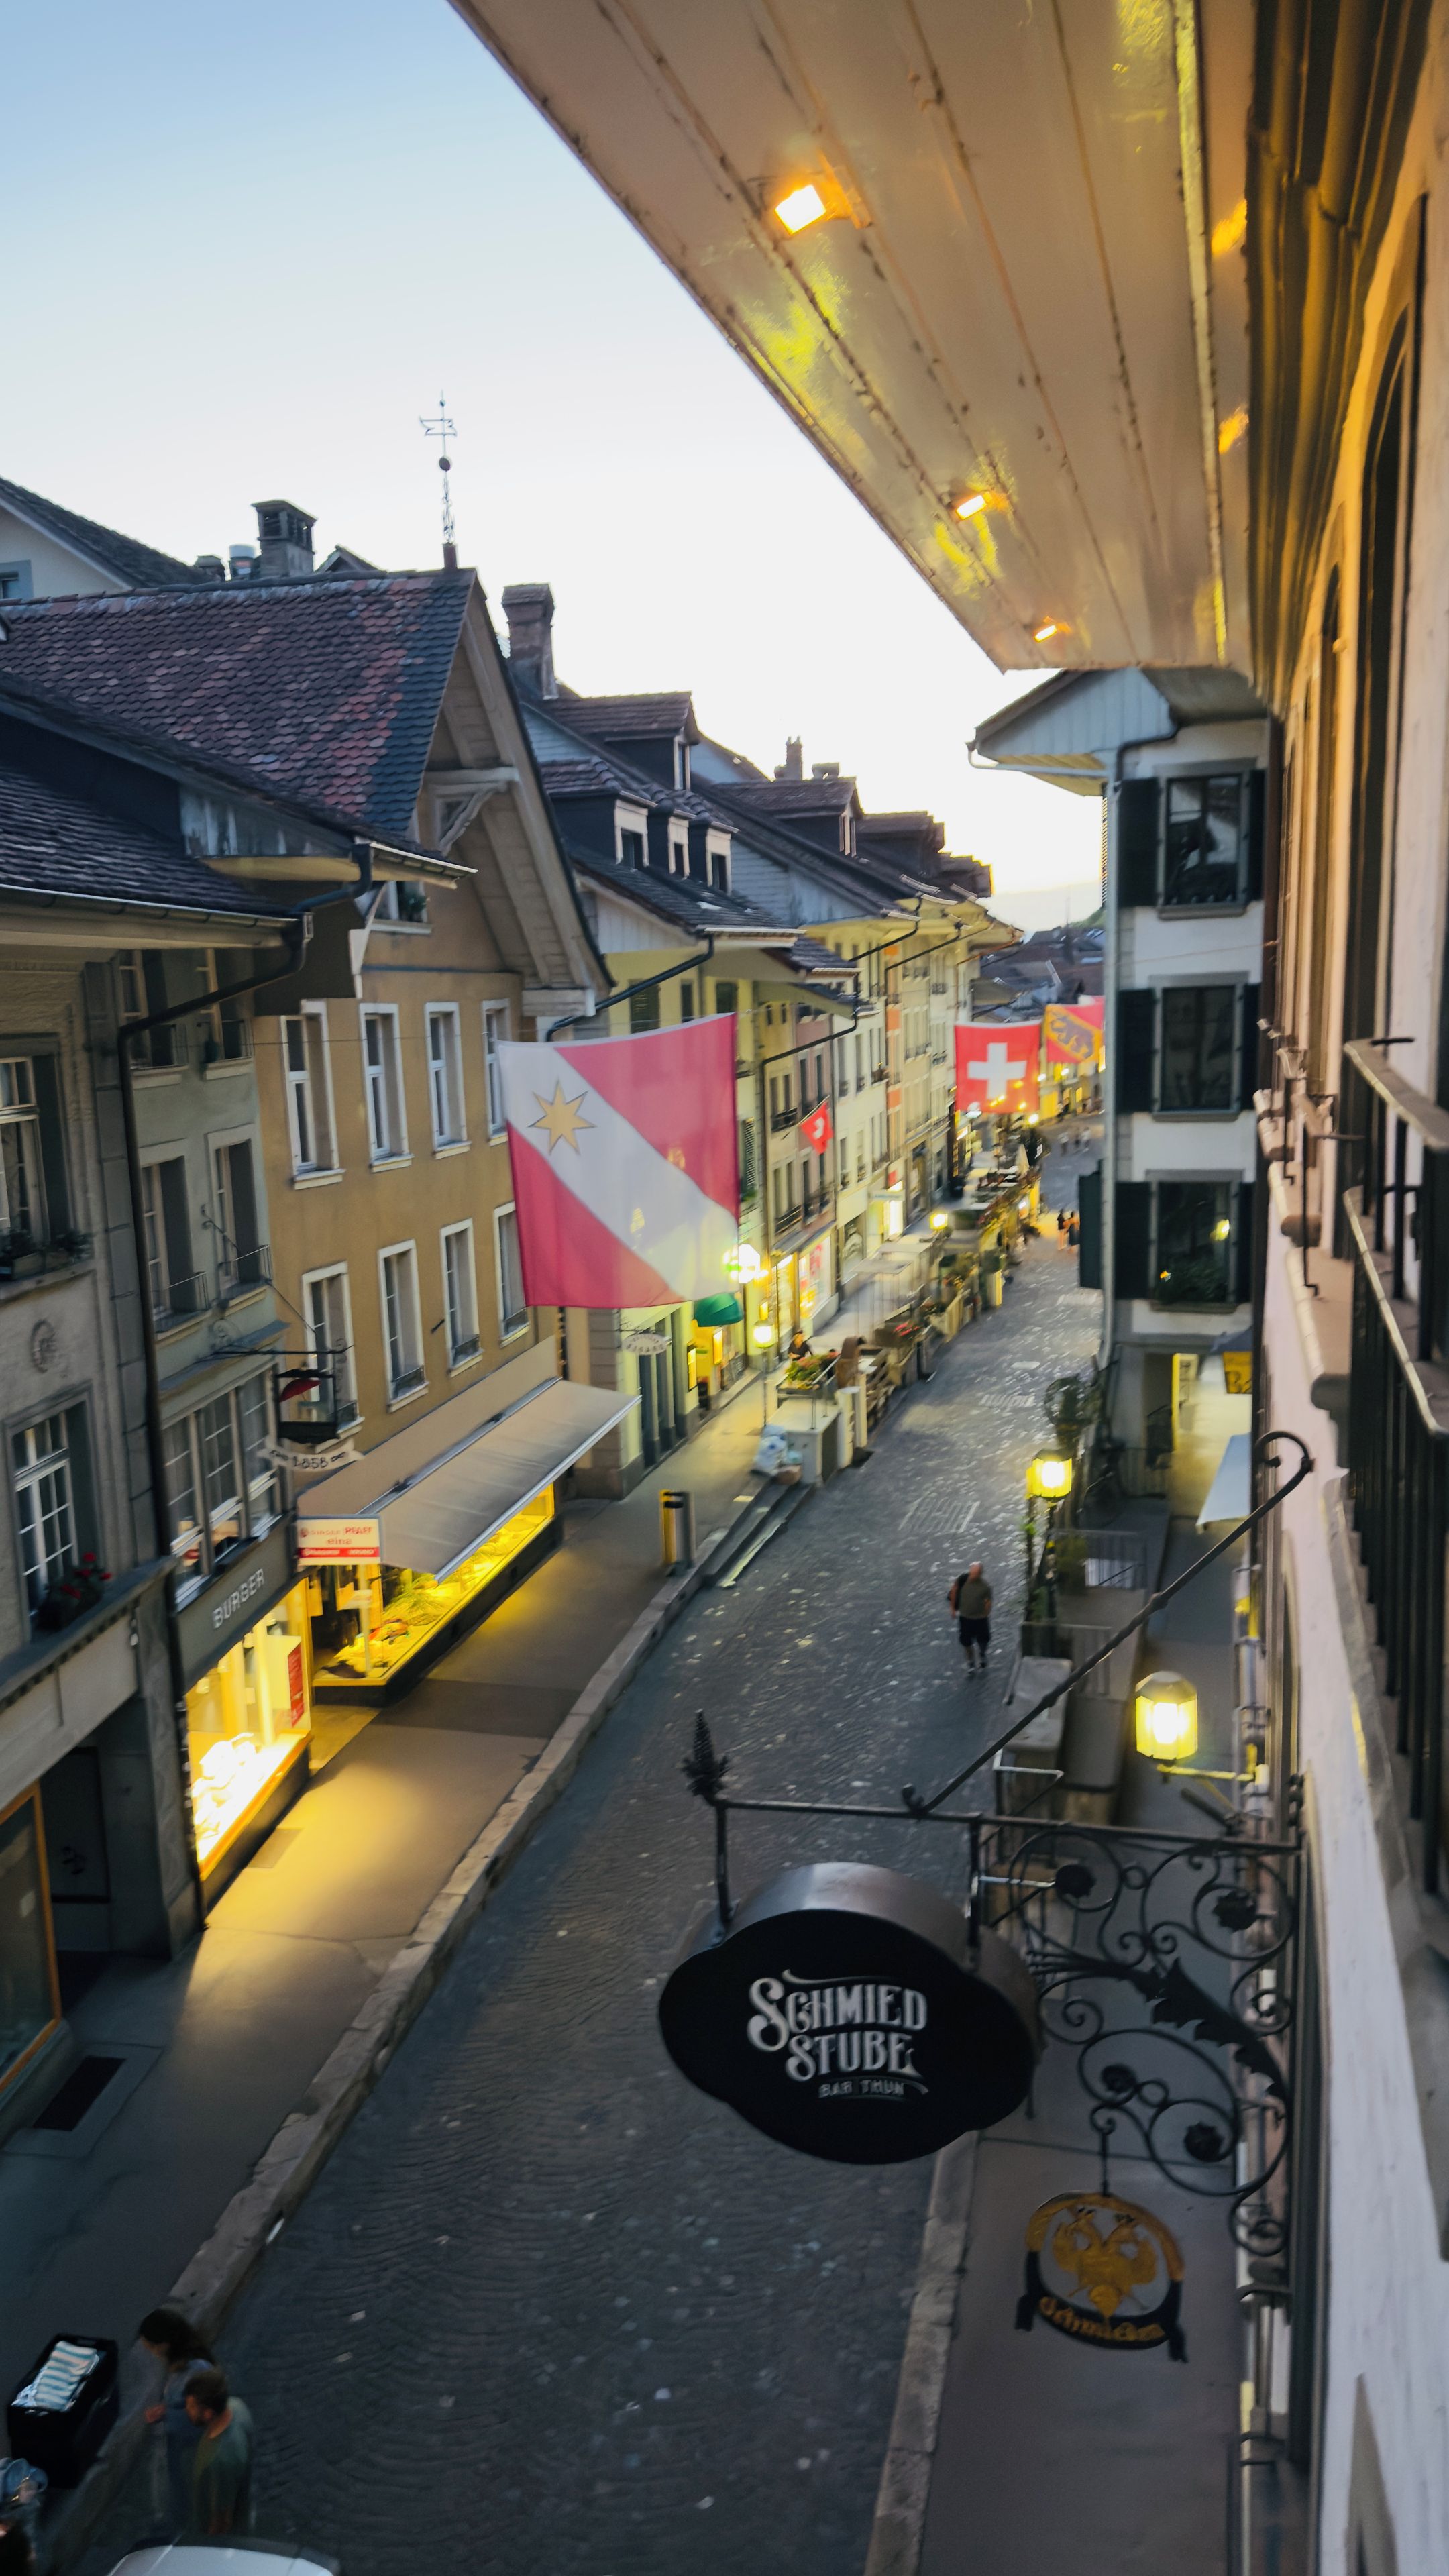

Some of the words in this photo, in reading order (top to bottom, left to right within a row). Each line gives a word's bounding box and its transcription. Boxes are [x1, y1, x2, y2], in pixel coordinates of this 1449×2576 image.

[213, 1568, 265, 1629] BURGER
[747, 1978, 928, 2052] SCHMIED
[786, 2030, 923, 2082] STUBE
[818, 2080, 853, 2099] BAR
[859, 2079, 906, 2096] THUN
